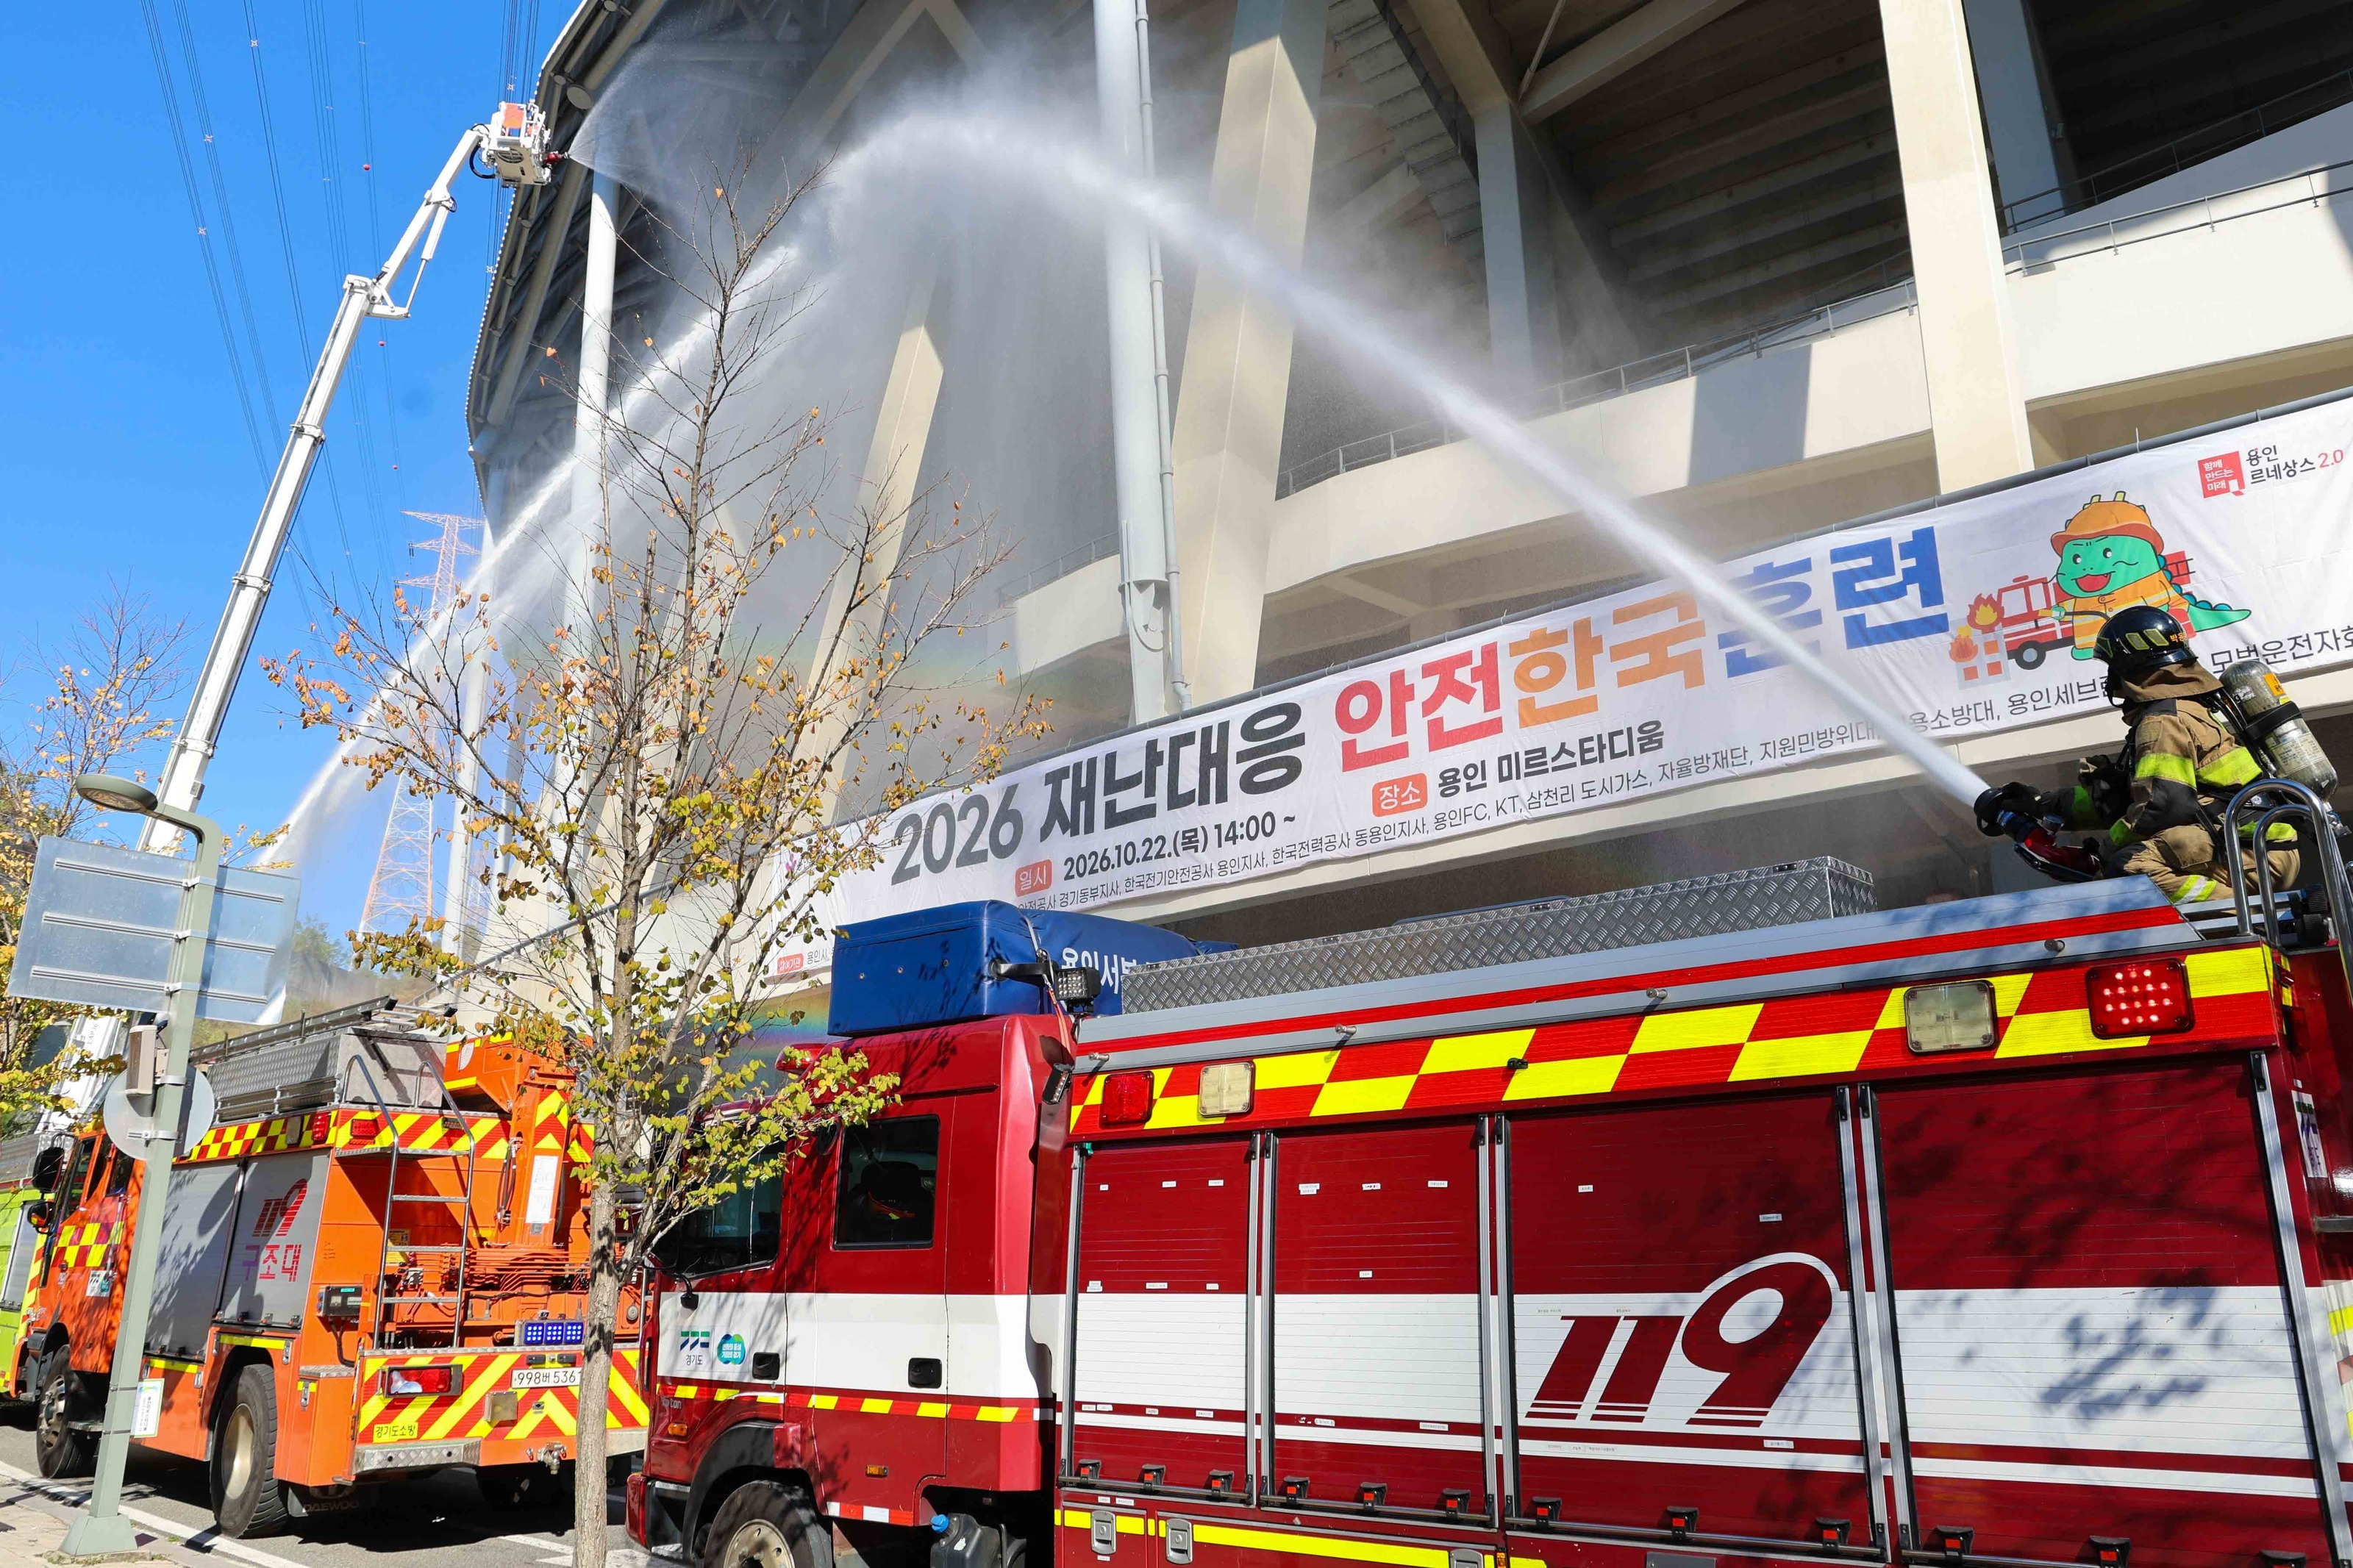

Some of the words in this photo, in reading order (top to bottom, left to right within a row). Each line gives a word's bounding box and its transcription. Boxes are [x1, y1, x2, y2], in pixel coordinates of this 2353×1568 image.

[2203, 459, 2223, 471] 함께
[2246, 445, 2279, 466] 용인
[2251, 458, 2315, 484] 르네상스
[2318, 449, 2343, 468] 2.0
[2205, 469, 2234, 482] 만드는
[2207, 479, 2227, 490] 미래
[1378, 781, 1422, 810] 장소
[1438, 763, 1487, 798] 용인
[1498, 720, 1665, 784] 미르스타디움
[891, 783, 1024, 886] 2026
[1040, 702, 1306, 842] 재난대응
[1060, 881, 1121, 908] 경기동부지사,
[1124, 863, 1214, 894] 한국전기안전공사
[1217, 854, 1270, 878] 용인지사,
[1272, 836, 1351, 866] 한국전력공사
[1355, 816, 1429, 846] 동용인지사,
[1434, 802, 1491, 831] 용인FC,
[1496, 795, 1524, 816] KT,
[1527, 783, 1575, 810] 삼천리
[1582, 772, 1654, 801] 도시가스,
[1659, 746, 1754, 782] 자율방재단,
[1907, 700, 2001, 735] 용소방대,
[1019, 867, 1048, 892] 일시
[1063, 825, 1209, 881] 2026.10.22.(목)
[1214, 811, 1277, 849] 14:00
[243, 1245, 301, 1282] 구조대
[685, 1354, 703, 1367] 경기도
[1525, 1261, 1833, 1428] 119
[375, 1424, 416, 1439] 경기도소방
